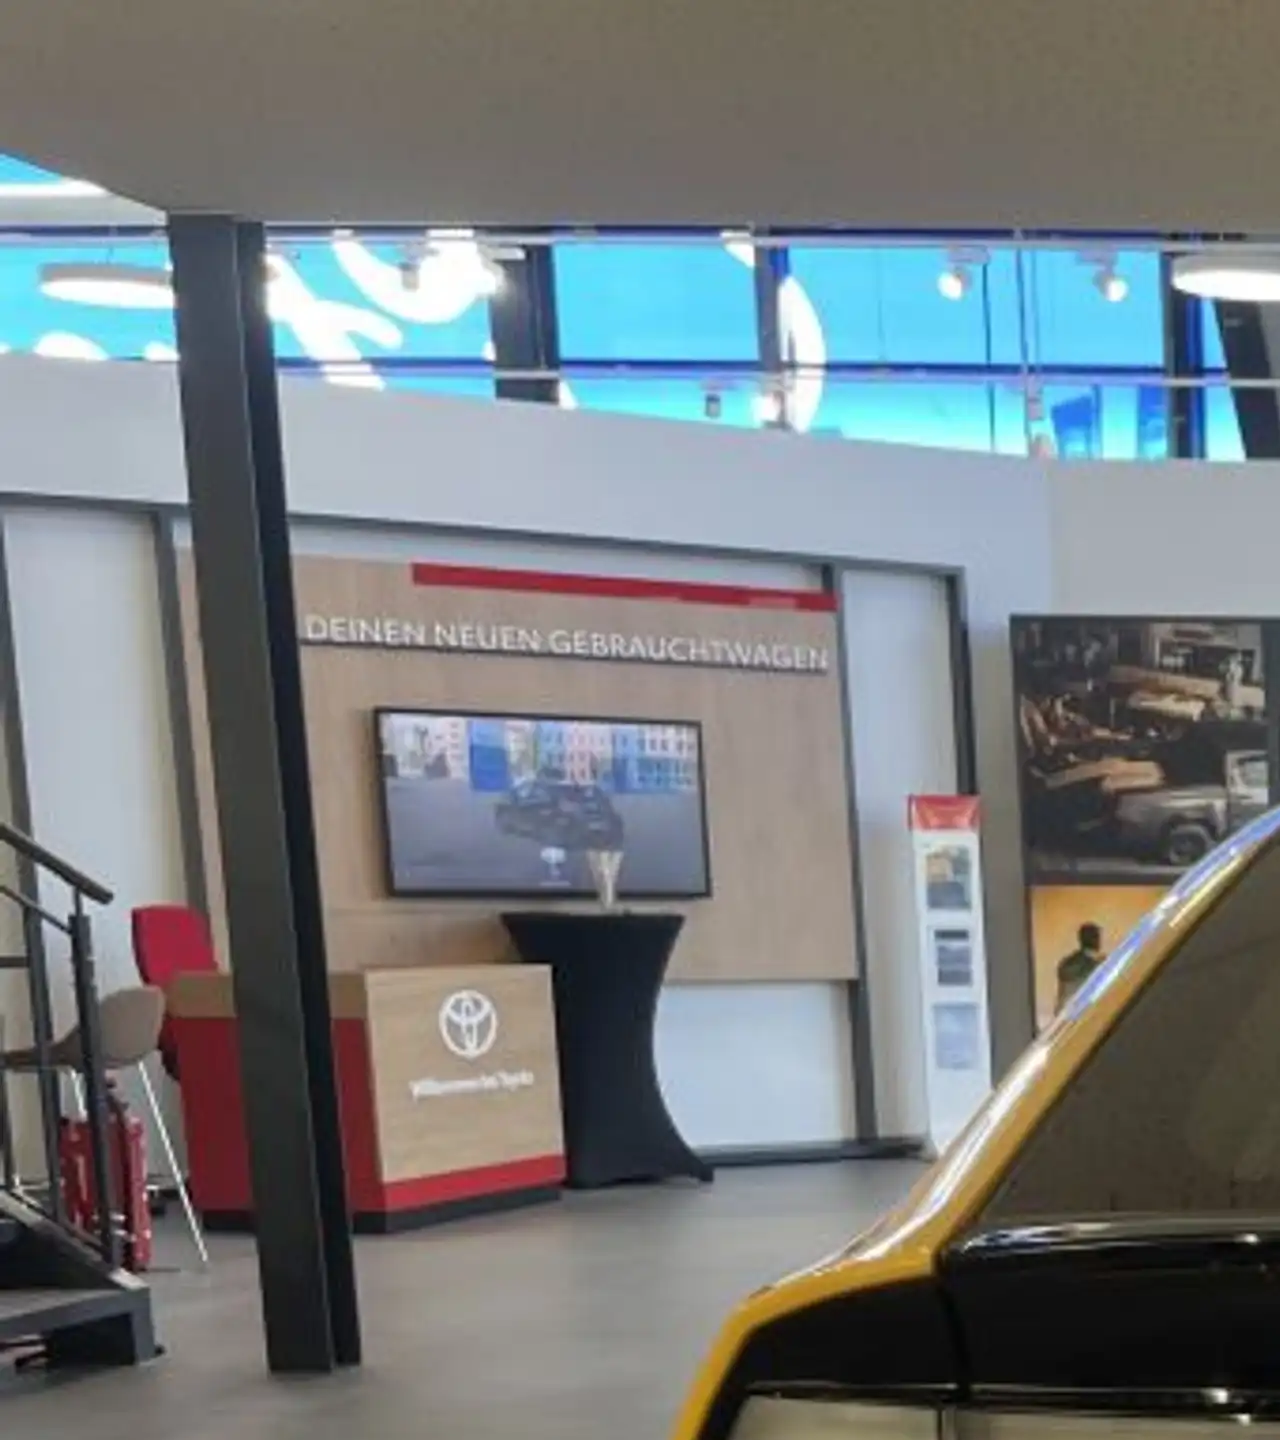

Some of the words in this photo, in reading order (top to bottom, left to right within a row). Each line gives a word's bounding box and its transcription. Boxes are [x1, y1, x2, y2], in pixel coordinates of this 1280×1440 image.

[305, 614, 425, 645] DEINEN
[433, 622, 541, 651] NEUEN
[549, 629, 829, 670] GEBRAUCHTWAGEN
